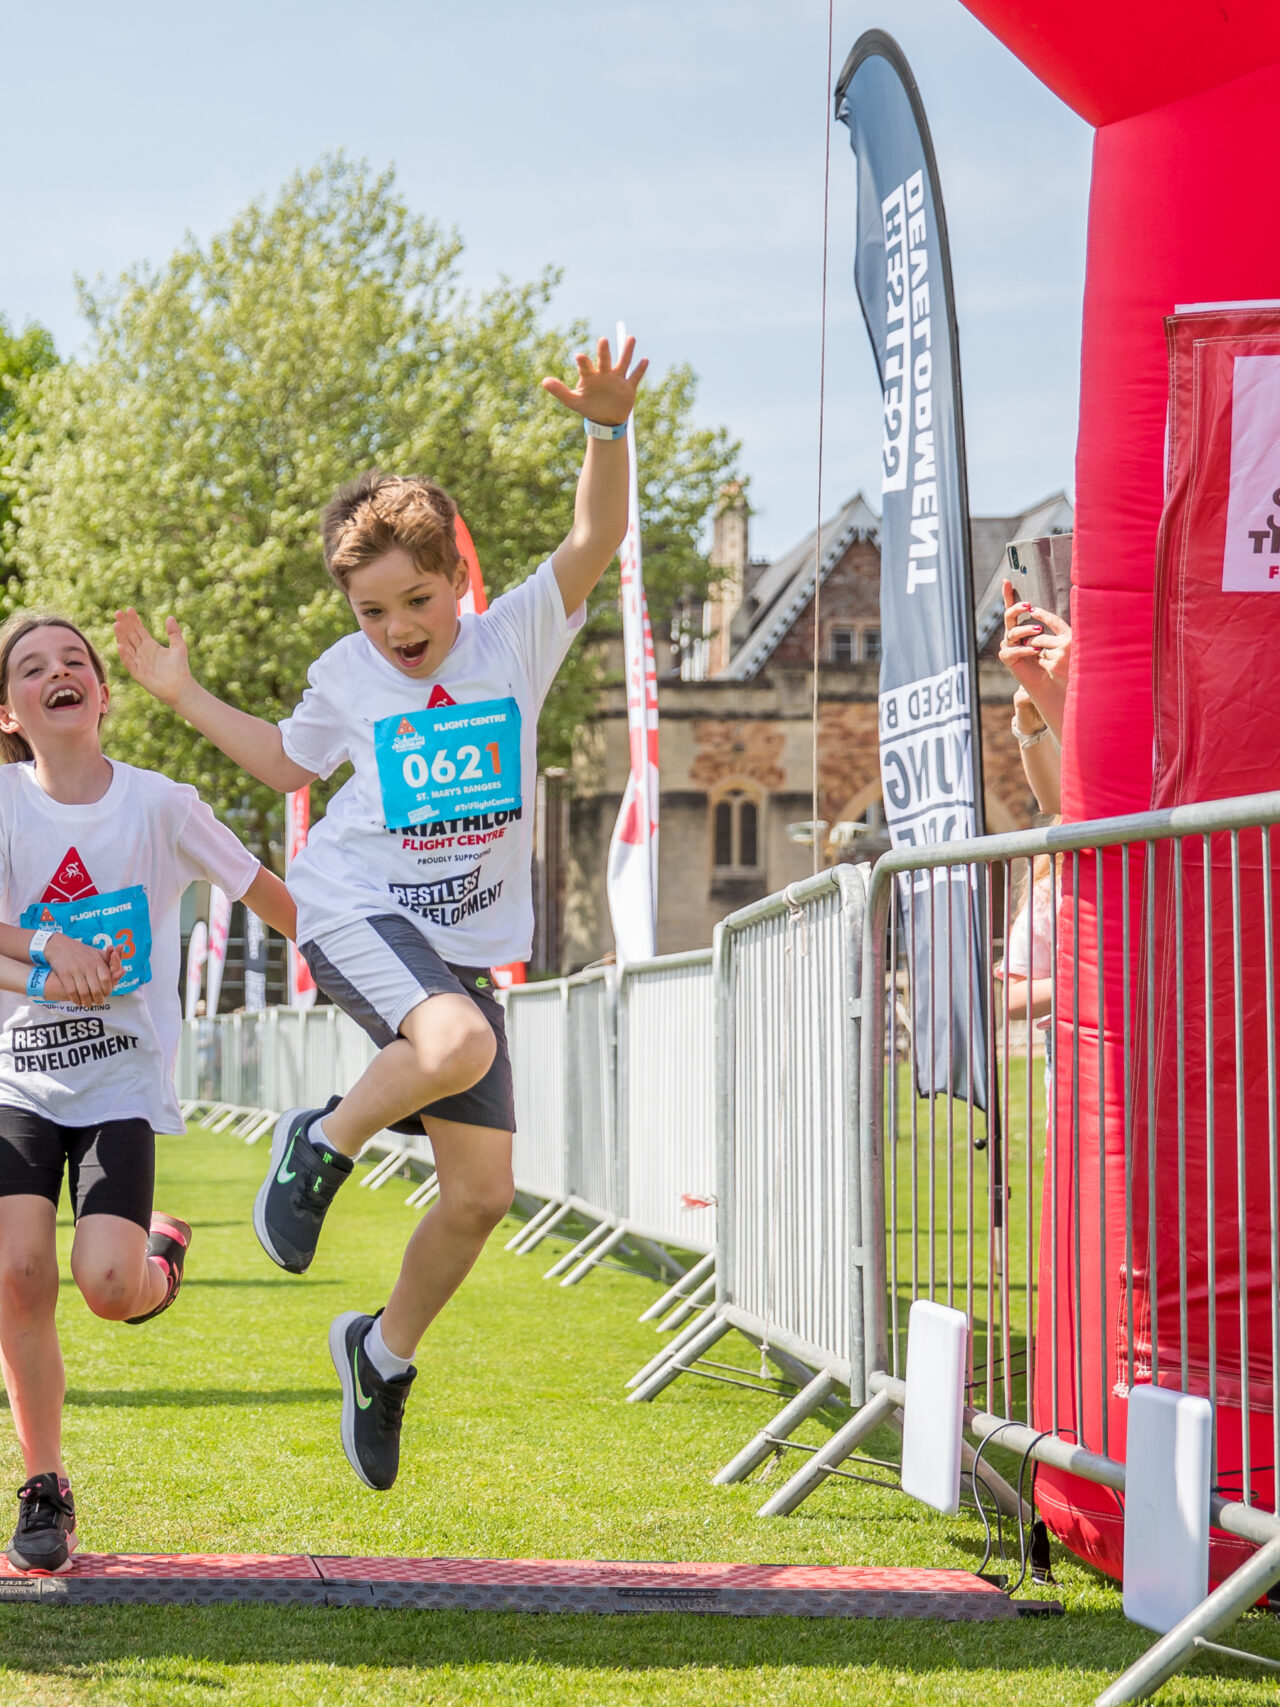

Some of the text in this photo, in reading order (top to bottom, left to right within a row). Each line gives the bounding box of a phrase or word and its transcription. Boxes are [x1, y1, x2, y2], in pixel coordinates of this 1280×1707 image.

[433, 714, 506, 732] FLIGHT CENTRE
[402, 742, 502, 788] 0621
[416, 793, 429, 801] ST.
[463, 781, 501, 793] RANGERS
[402, 828, 505, 851] FLIGHT CENTRE
[417, 855, 452, 865] PROUDLY
[392, 870, 479, 905] RESTLESS
[70, 902, 132, 922] FLIGHT CENTRE
[66, 1003, 111, 1012] SUPPORTING
[15, 1019, 100, 1050] RESTLESS
[14, 1035, 139, 1073] DEVELOPMENT
